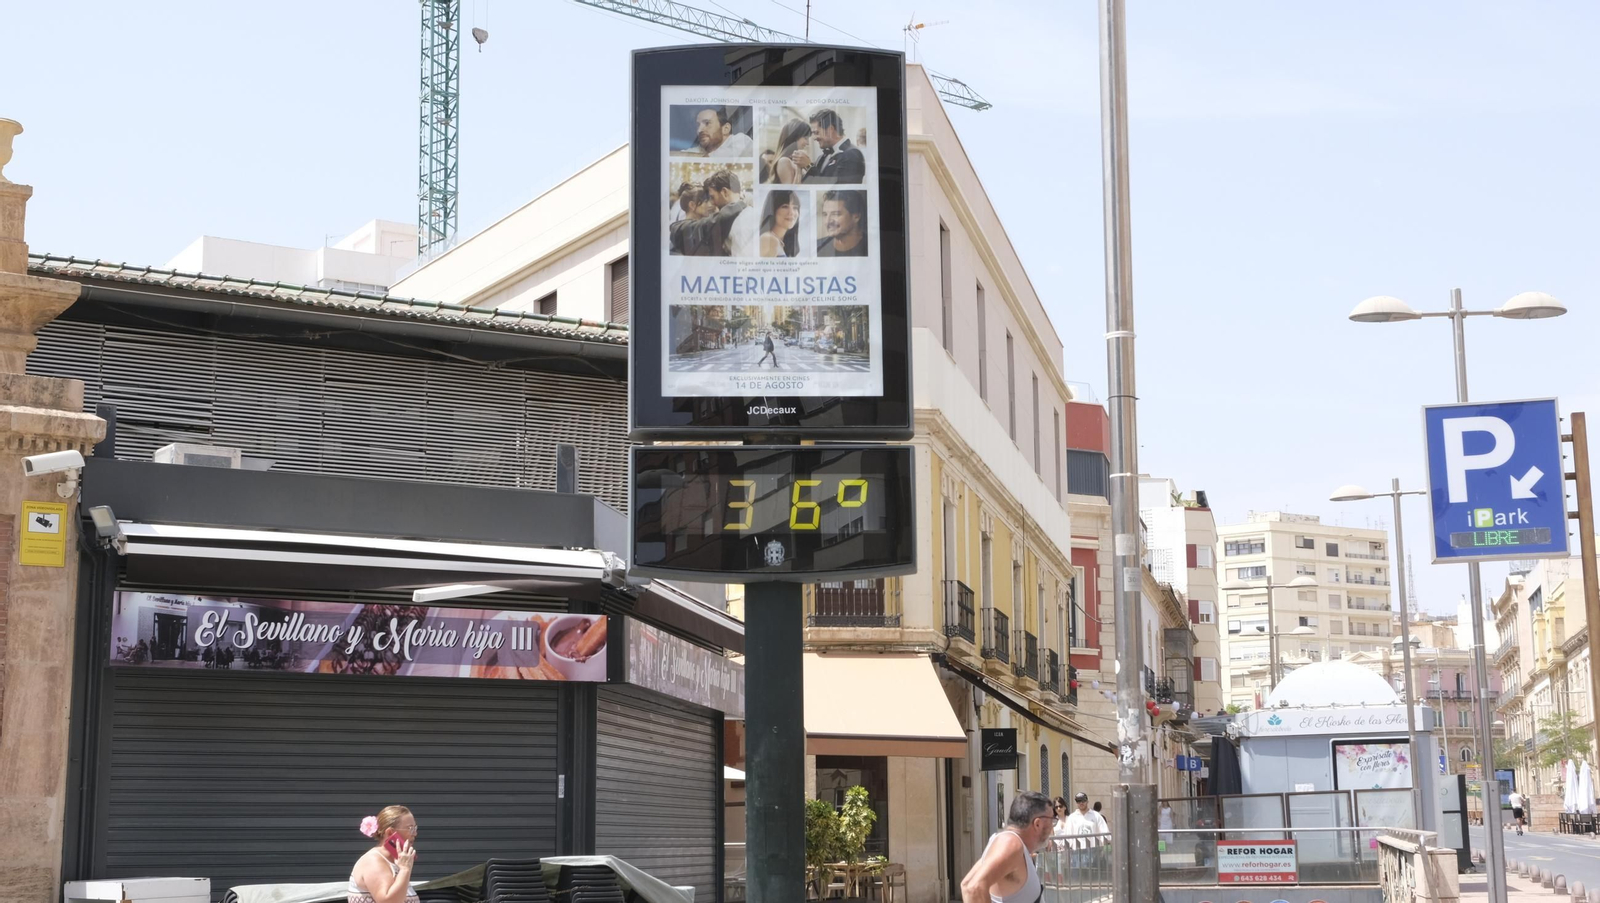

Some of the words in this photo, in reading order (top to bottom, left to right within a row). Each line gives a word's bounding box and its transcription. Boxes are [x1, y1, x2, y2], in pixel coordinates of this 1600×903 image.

[681, 275, 858, 295] MATERIALISTAS
[736, 381, 746, 389] 14
[749, 381, 762, 389] DE
[764, 381, 804, 389] AGOSTO
[746, 405, 797, 415] JCDecaux
[1442, 416, 1516, 503] P
[1473, 530, 1519, 546] LIBRE
[194, 609, 230, 647] El
[232, 612, 344, 649] Sevillano
[344, 624, 365, 655] y
[461, 620, 506, 659] hija
[511, 626, 533, 651] III
[1299, 716, 1314, 729] El
[1314, 715, 1352, 729] Kiosko
[1354, 715, 1366, 726] de
[1368, 714, 1382, 725] las
[1371, 760, 1391, 772] flores
[1259, 847, 1293, 855] HOGAR
[1222, 861, 1291, 869] www.reforhogar.es
